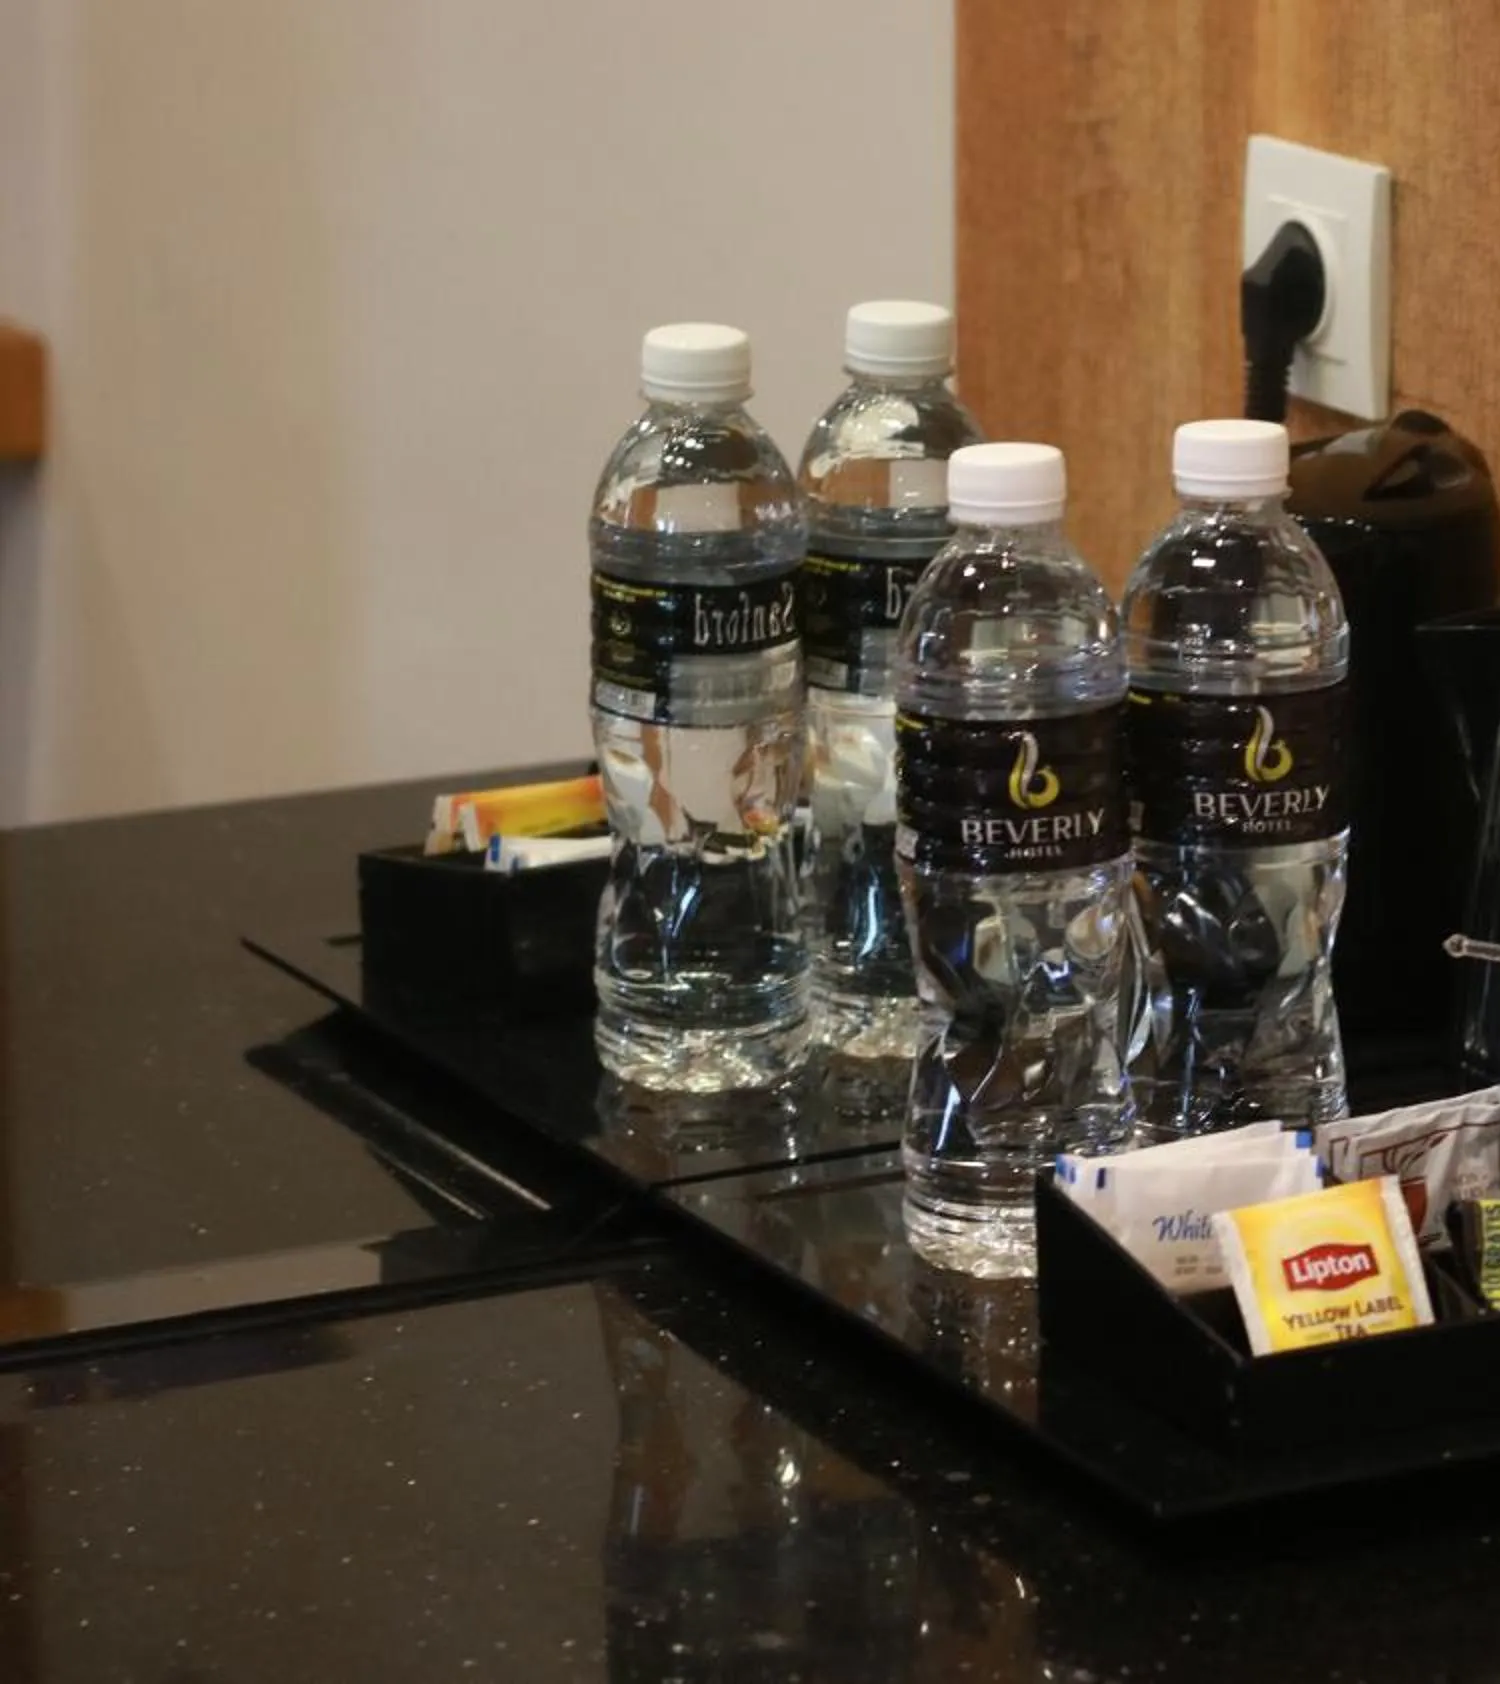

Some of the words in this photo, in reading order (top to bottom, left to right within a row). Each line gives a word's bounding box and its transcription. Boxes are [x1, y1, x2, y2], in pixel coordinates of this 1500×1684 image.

[1194, 784, 1331, 818] BEVERLY
[961, 808, 1106, 847] BEVERLY
[1289, 1251, 1372, 1286] Lipton
[1282, 1304, 1352, 1330] YELLOW
[1354, 1295, 1404, 1318] LABEL
[1334, 1323, 1369, 1341] TEA
